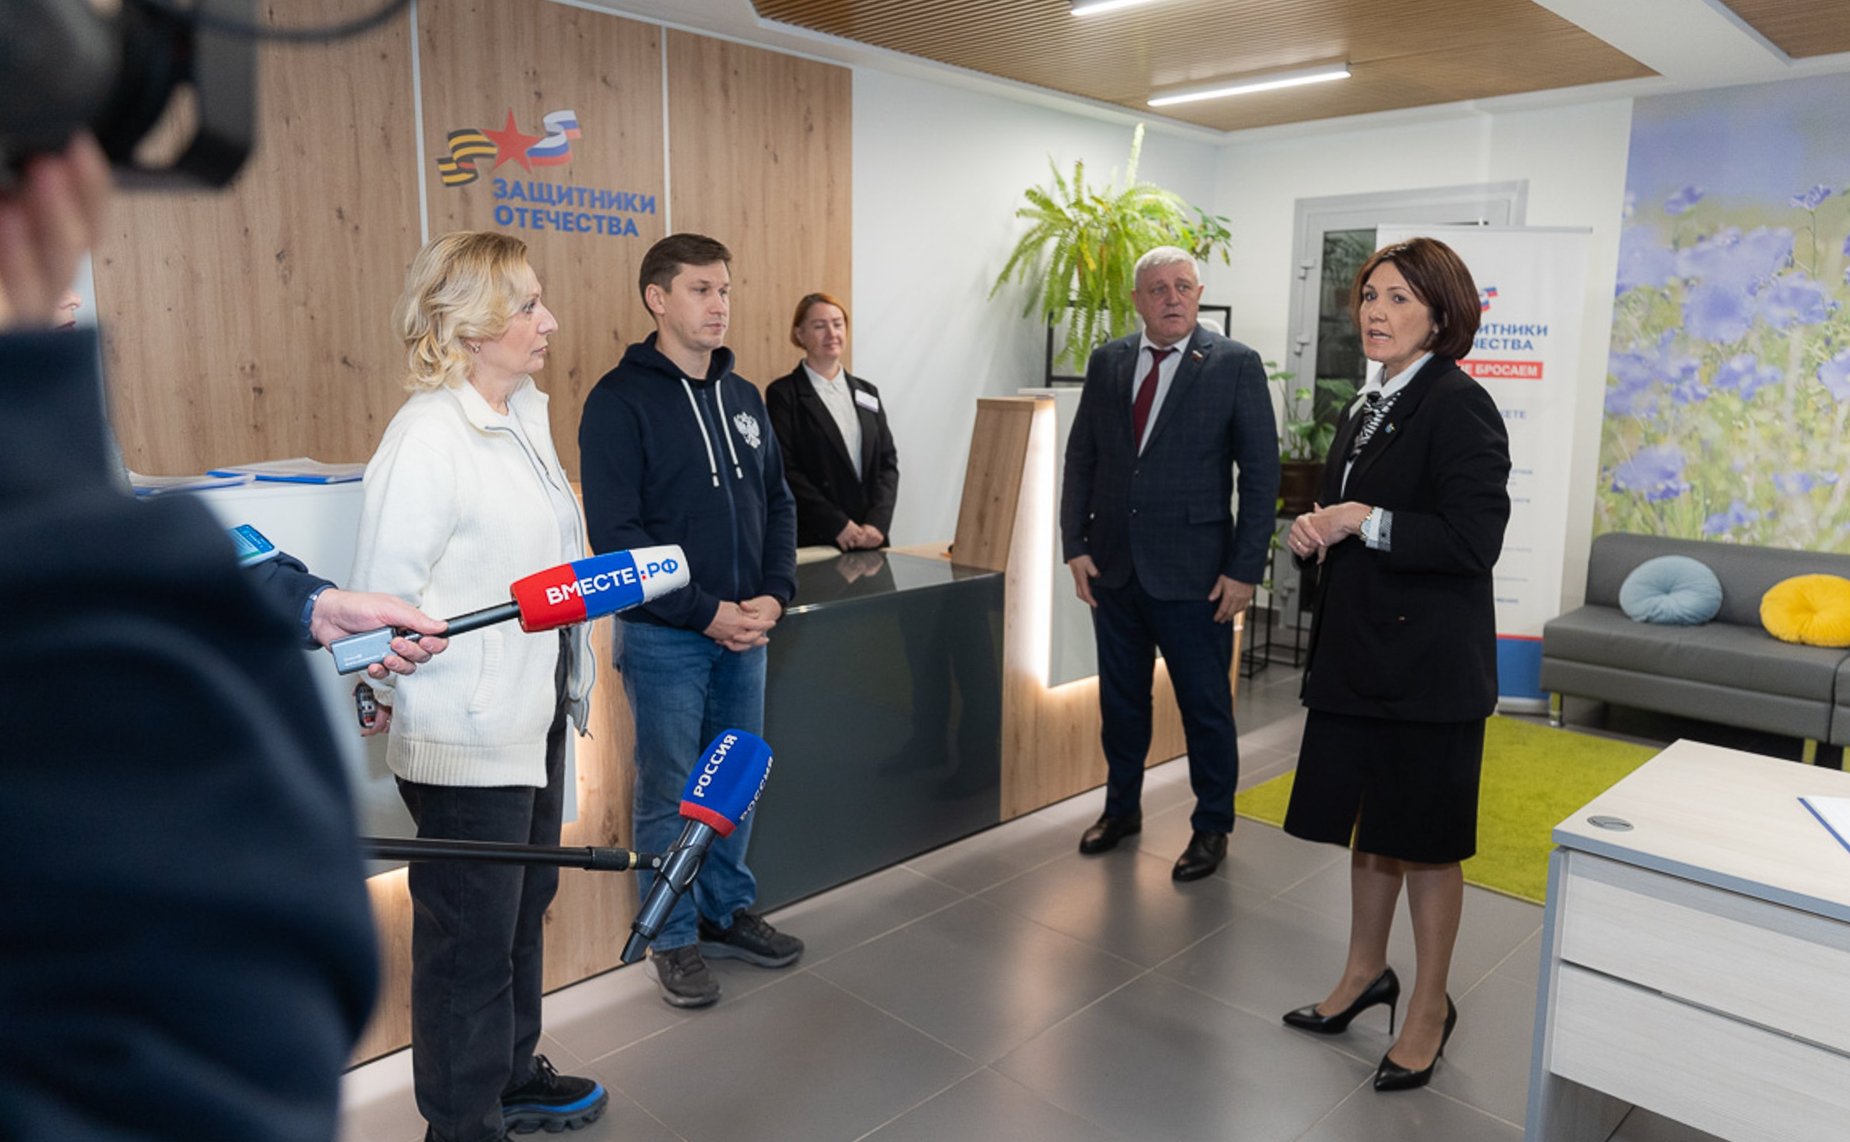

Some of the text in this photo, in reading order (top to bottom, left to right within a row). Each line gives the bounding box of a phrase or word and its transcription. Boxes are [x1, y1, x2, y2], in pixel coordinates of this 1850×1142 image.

[492, 177, 656, 215] ЗАЩИТНИКИ
[494, 204, 640, 237] ОТЕЧЕСТВА
[1478, 322, 1548, 337] ИТНИКИ
[1475, 363, 1537, 377] БРОСАЕМ
[692, 734, 738, 798] РОССИЯ
